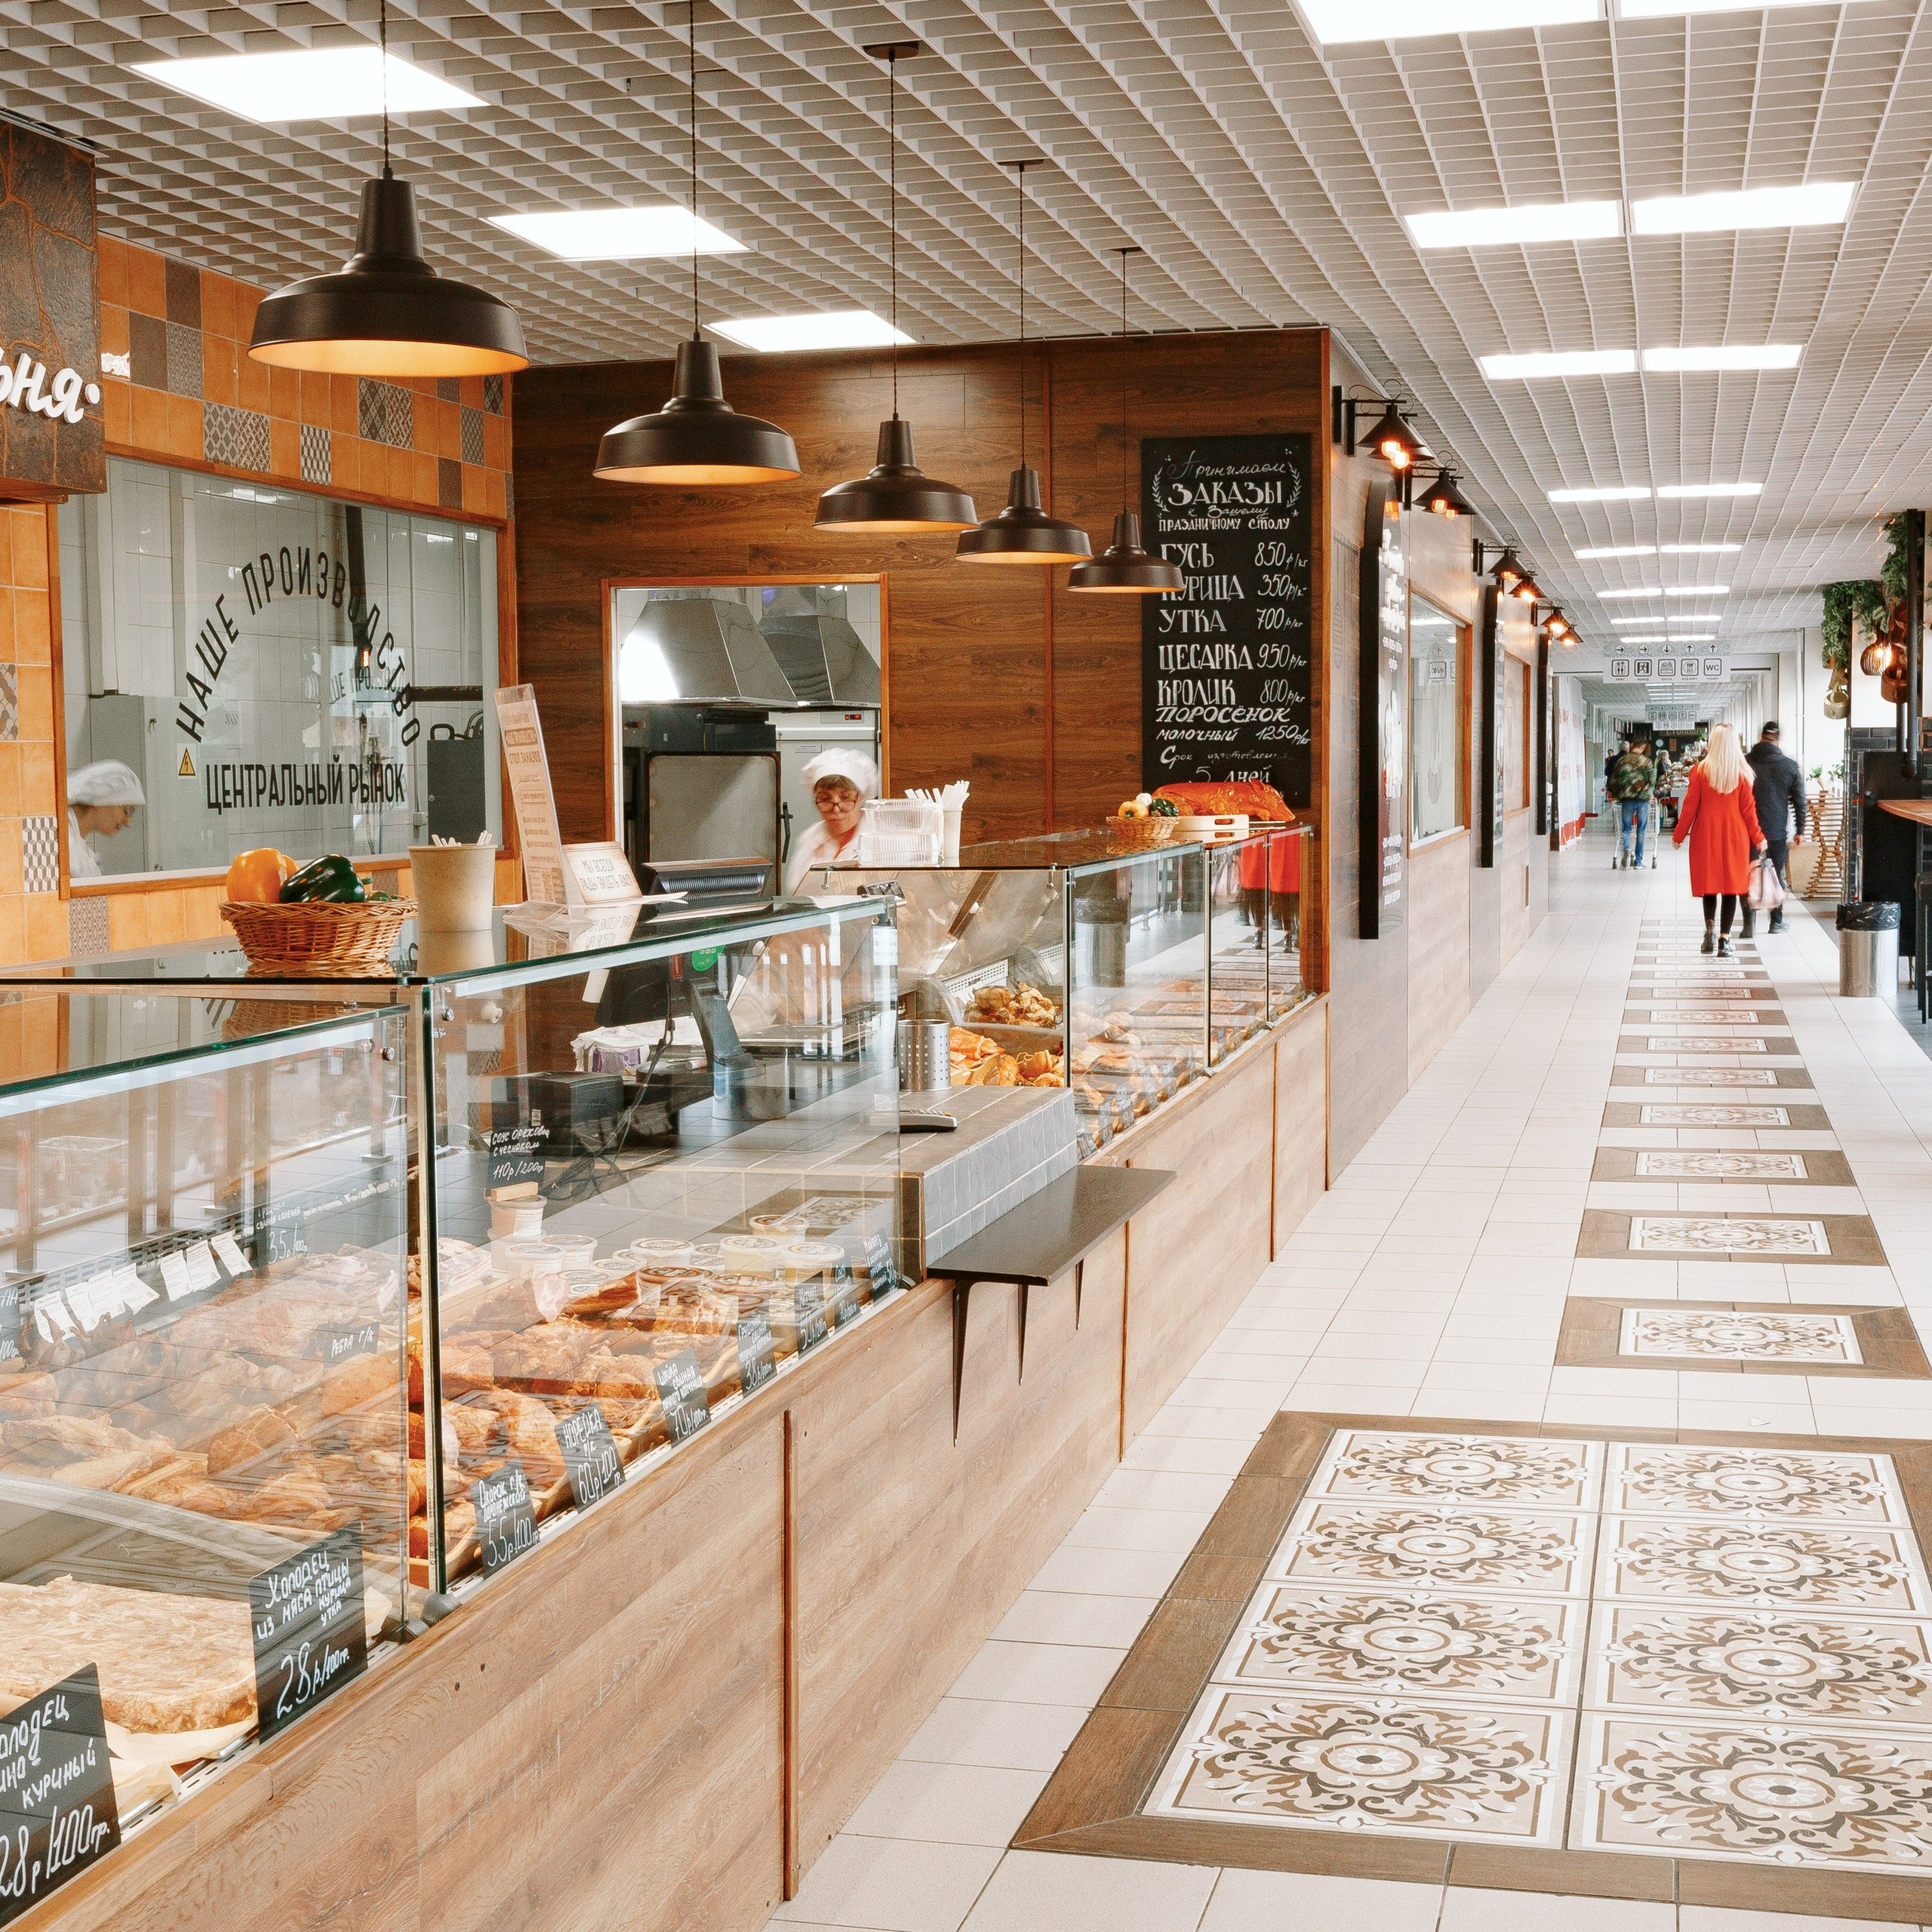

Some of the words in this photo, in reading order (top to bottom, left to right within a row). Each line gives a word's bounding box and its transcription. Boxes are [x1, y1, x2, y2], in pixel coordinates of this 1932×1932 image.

[1168, 481, 1282, 506] ЗАКАЗЫ
[1158, 518, 1241, 531] ПРАЗДНИЧНОМУ
[1160, 543, 1215, 568] ГУСЬ
[1158, 609, 1228, 633] УТКА
[176, 593, 240, 743] НАШЕ
[242, 546, 421, 747] ПРОИЗВОДСТВО
[1158, 644, 1254, 674] ЦЕСАРКА
[1158, 679, 1237, 706] КРОЛИК
[1160, 745, 1193, 770] Срок
[206, 755, 344, 815] ЦЕНТРАЛЬНЫЙ
[349, 761, 405, 804] РЫНОК
[257, 1616, 275, 1640] ИЗ
[281, 1587, 313, 1625] МЯСА
[315, 1558, 350, 1598] ПТИЦЫ
[318, 1580, 352, 1612] КУРИЦА
[320, 1601, 342, 1627] УТКА
